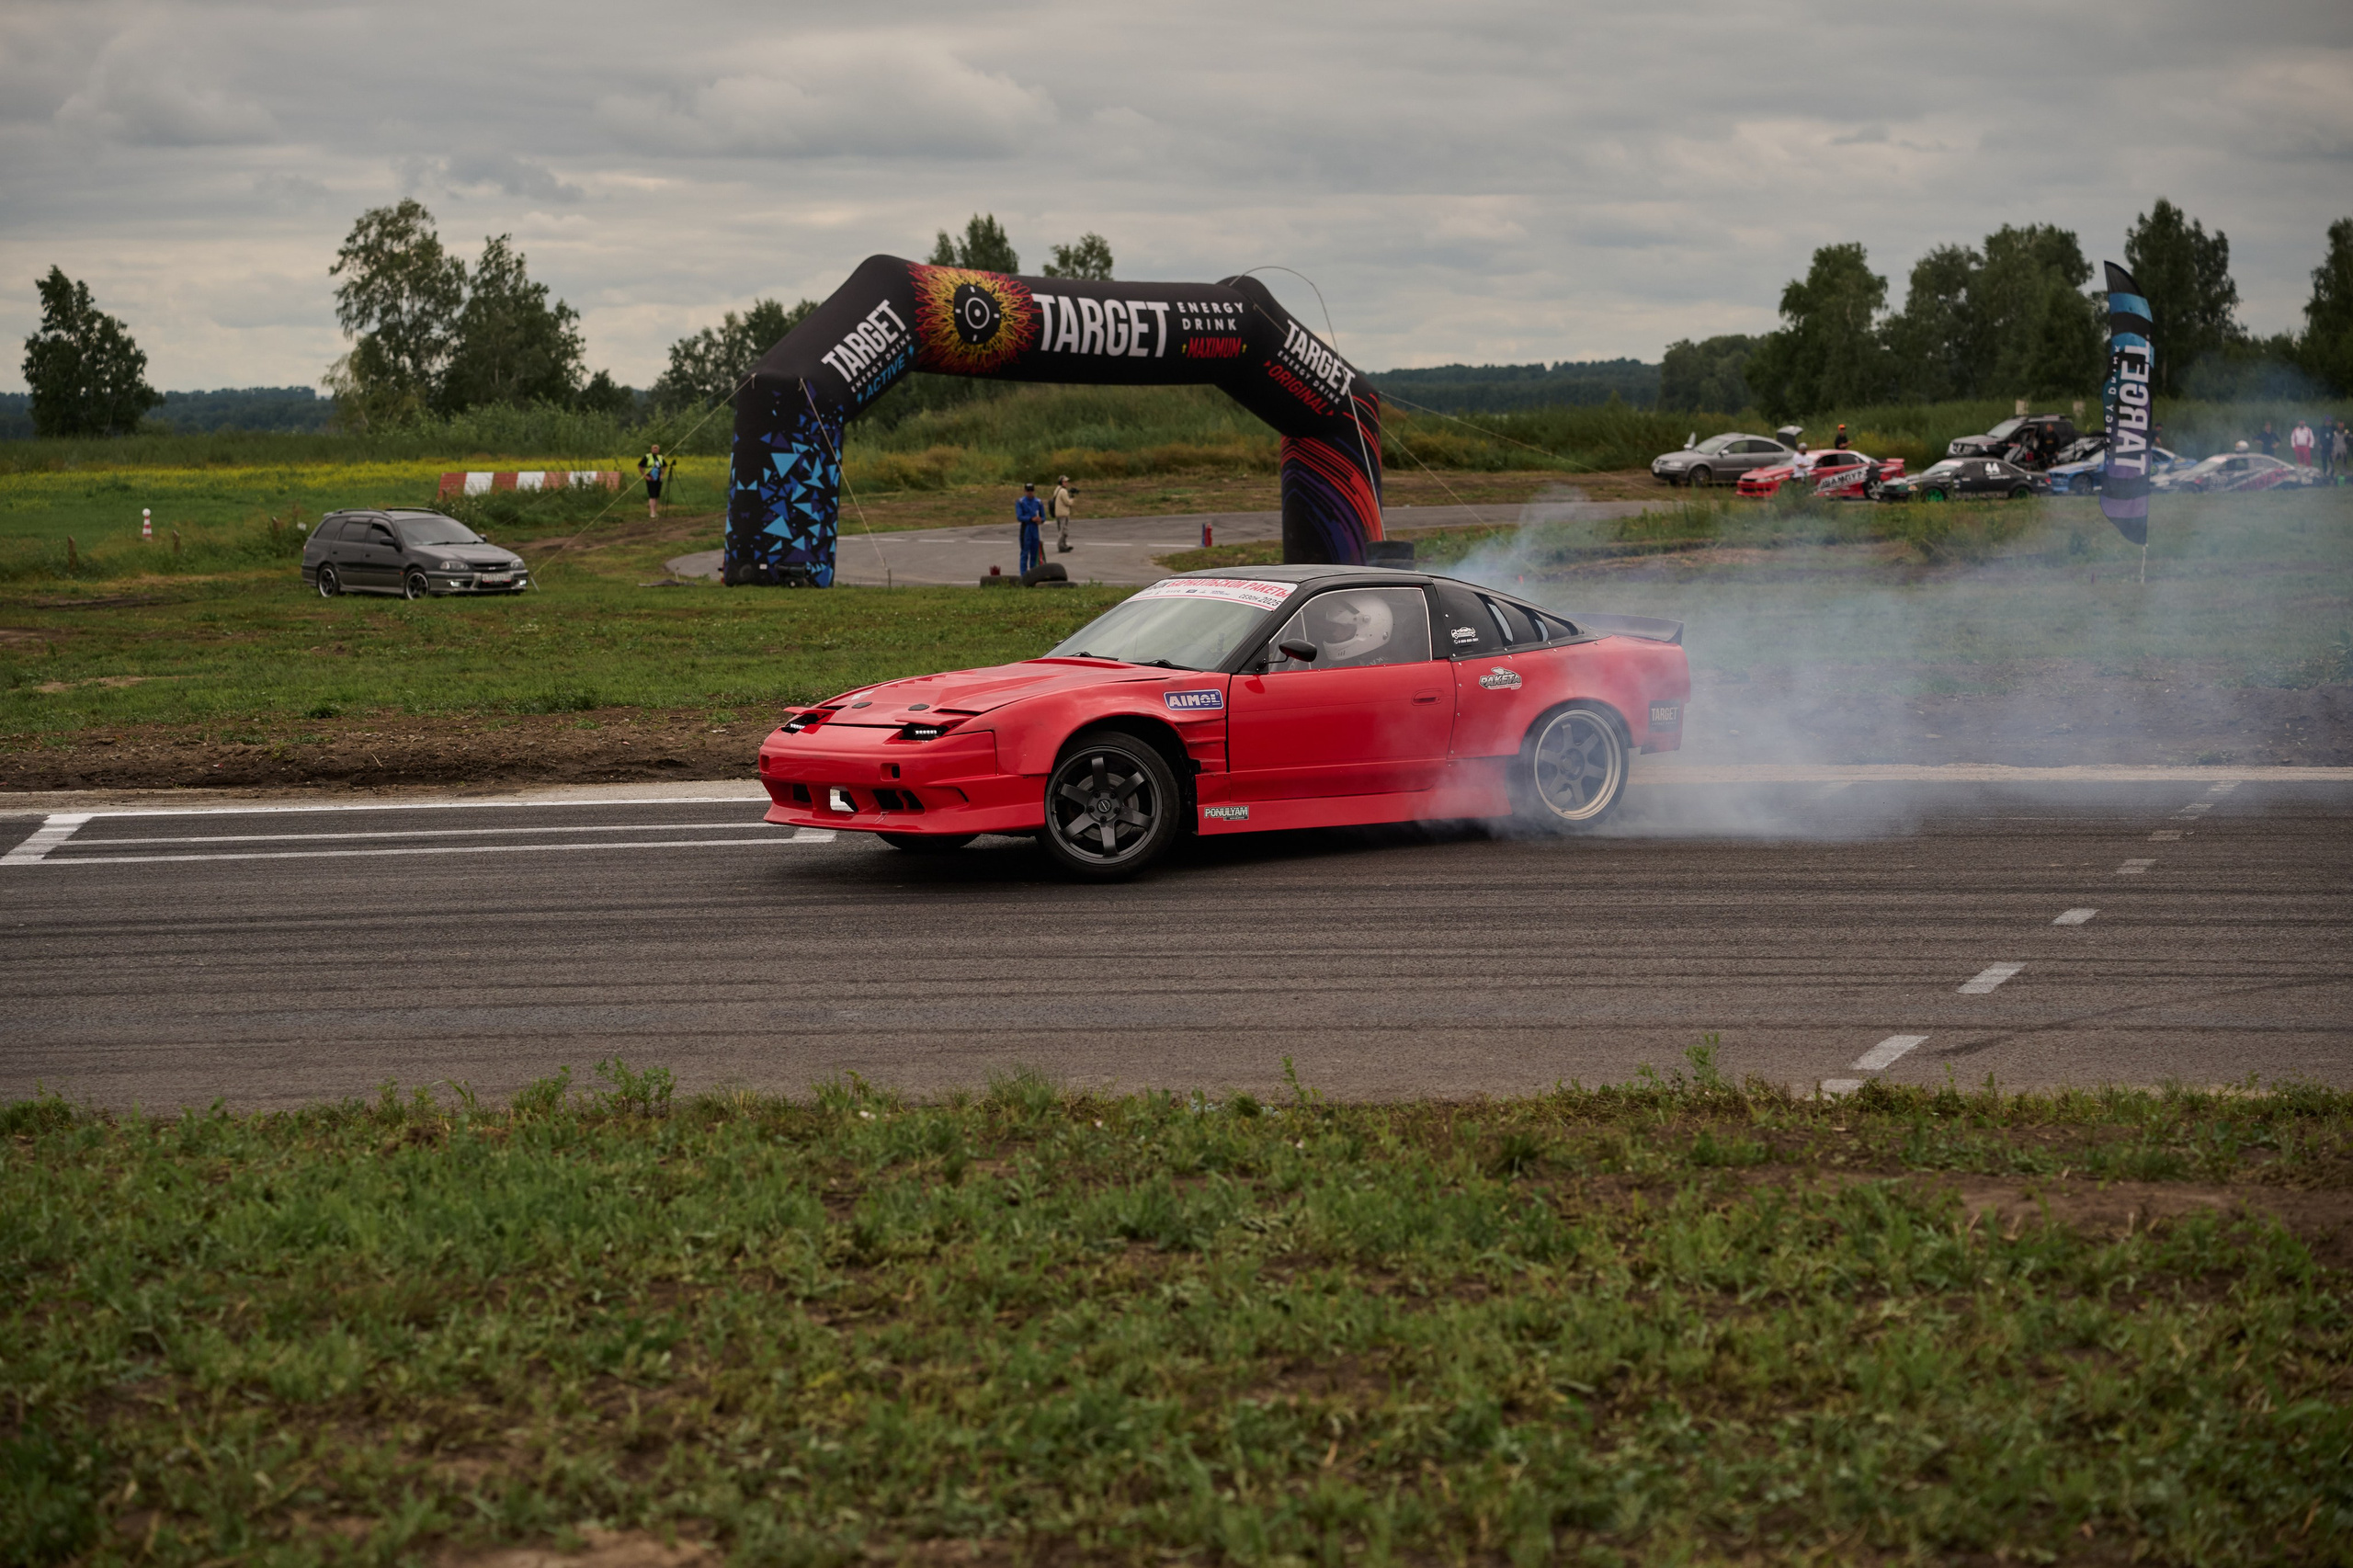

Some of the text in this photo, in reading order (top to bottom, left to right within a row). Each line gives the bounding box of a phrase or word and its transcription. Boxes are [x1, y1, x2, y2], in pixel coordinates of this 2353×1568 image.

[1176, 301, 1244, 313] ENERGY
[1031, 293, 1170, 358] TARGET
[1182, 318, 1237, 331] DRINK
[821, 299, 906, 382] TARGET
[1187, 336, 1242, 358] MAXIMUM
[851, 333, 912, 392] ENERGY DRINK
[1283, 319, 1356, 396] TARGET
[866, 353, 905, 400] ACTIVE
[1277, 350, 1341, 404] ENERGY DRINK
[1268, 365, 1328, 415] ORIGINAL
[1243, 582, 1291, 598] РАКЕТЫ
[1258, 597, 1281, 607] 2025
[1169, 694, 1221, 707] AIMOL
[1651, 707, 1678, 722] TARGET
[1205, 807, 1248, 817] PONULYAM
